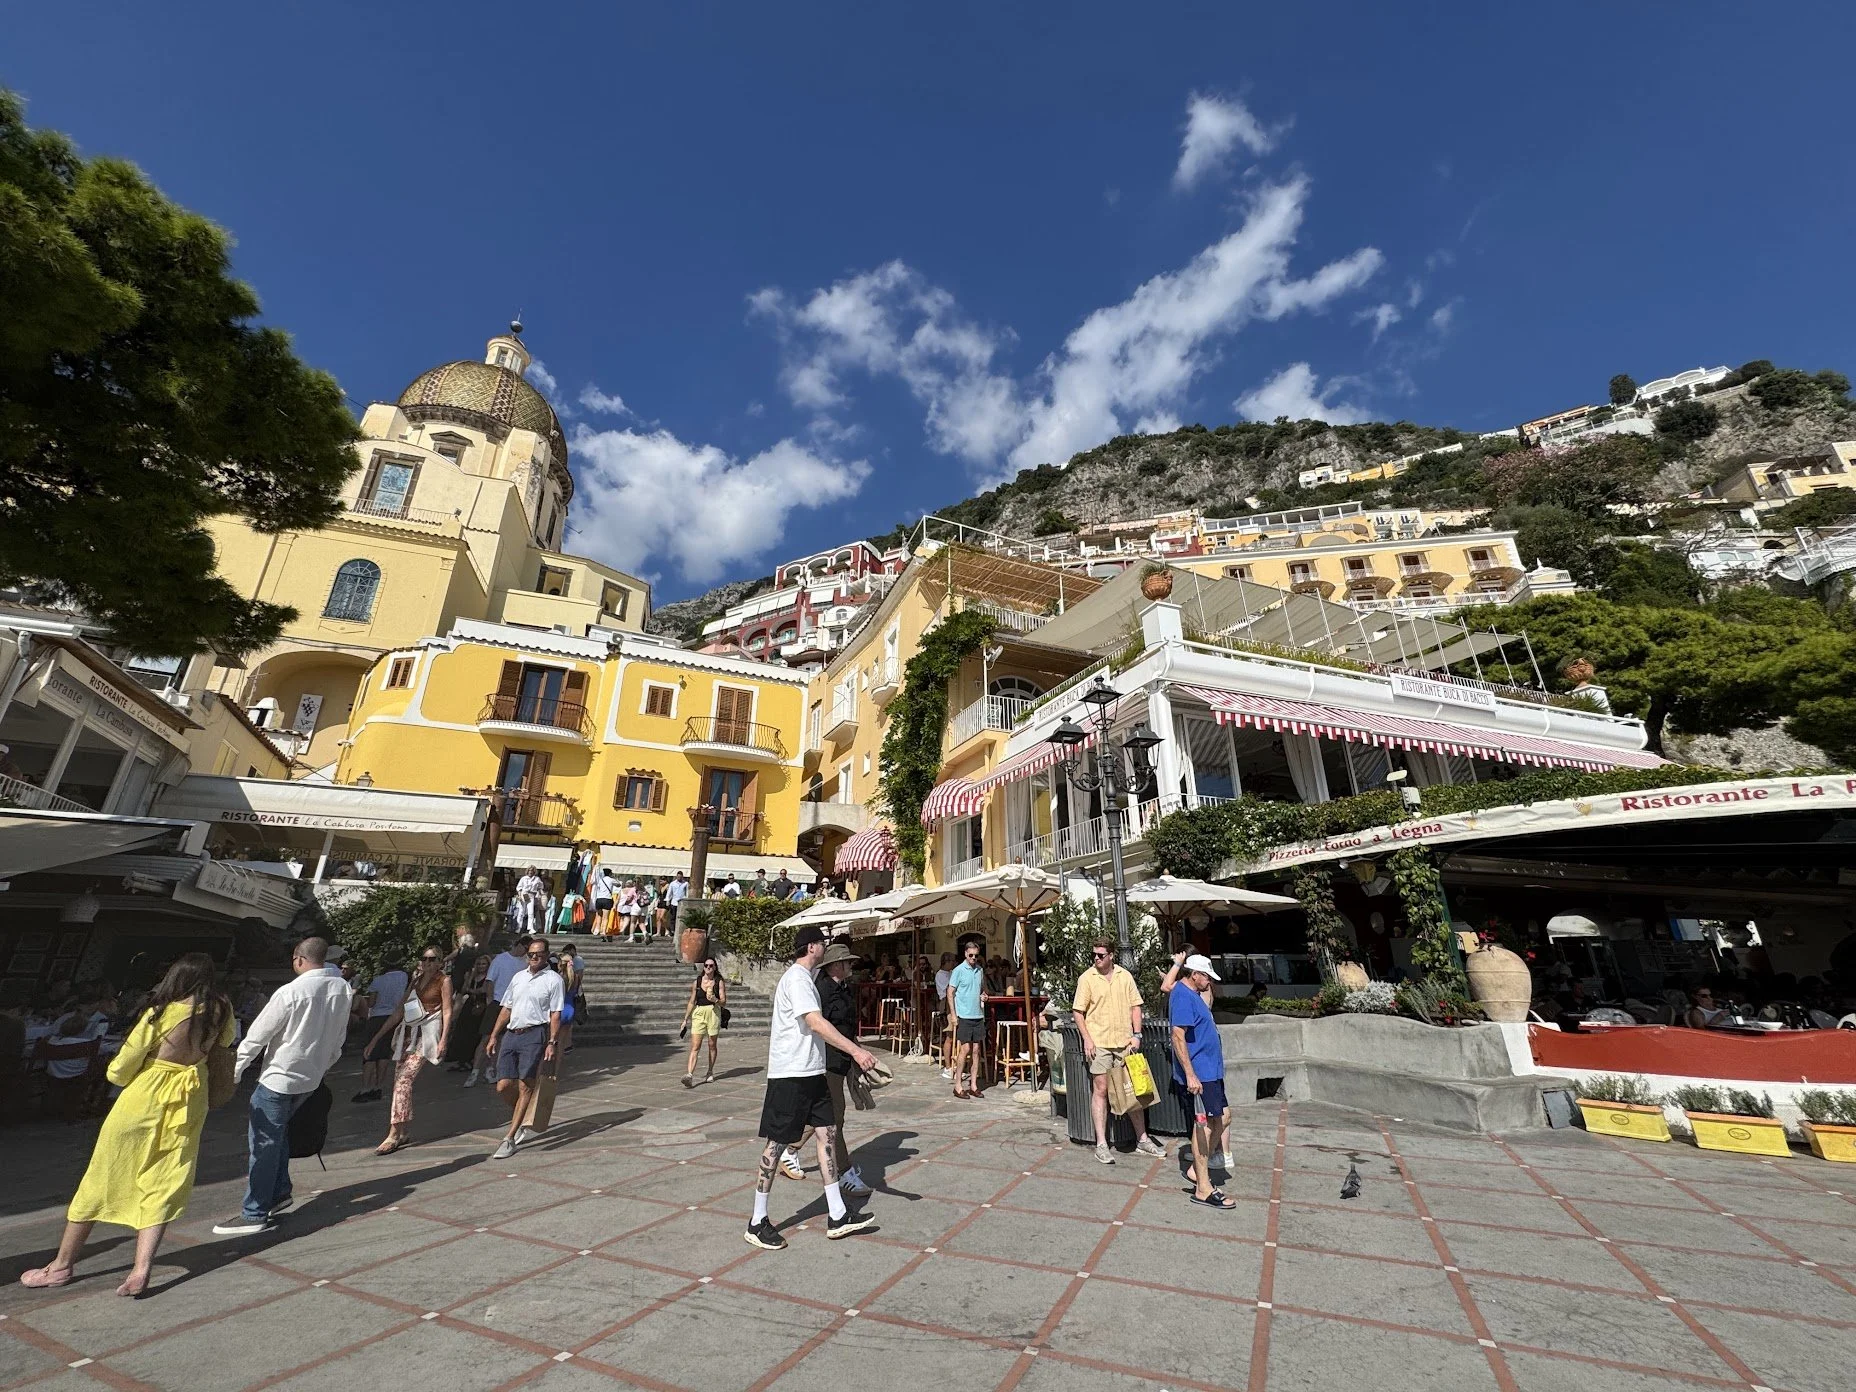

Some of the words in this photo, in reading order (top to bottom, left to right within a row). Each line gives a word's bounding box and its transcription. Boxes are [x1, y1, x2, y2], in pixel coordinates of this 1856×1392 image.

[89, 675, 128, 709] RISTORANTE
[1039, 698, 1066, 720] RISTORANTE
[1067, 690, 1080, 705] BUCA
[1400, 679, 1441, 697] RISTORANTE
[1443, 687, 1461, 701] BUCA
[1462, 690, 1469, 702] DI
[1470, 692, 1490, 706] BACCO
[96, 705, 105, 718] La
[106, 710, 133, 737] Cambusa
[1620, 787, 1769, 811] Ristorante
[1791, 782, 1825, 797] La
[221, 811, 300, 825] RISTORANTE
[304, 816, 319, 826] La
[1268, 846, 1316, 862] Pizzeria
[1373, 833, 1383, 844] a
[1391, 822, 1444, 839] Legna
